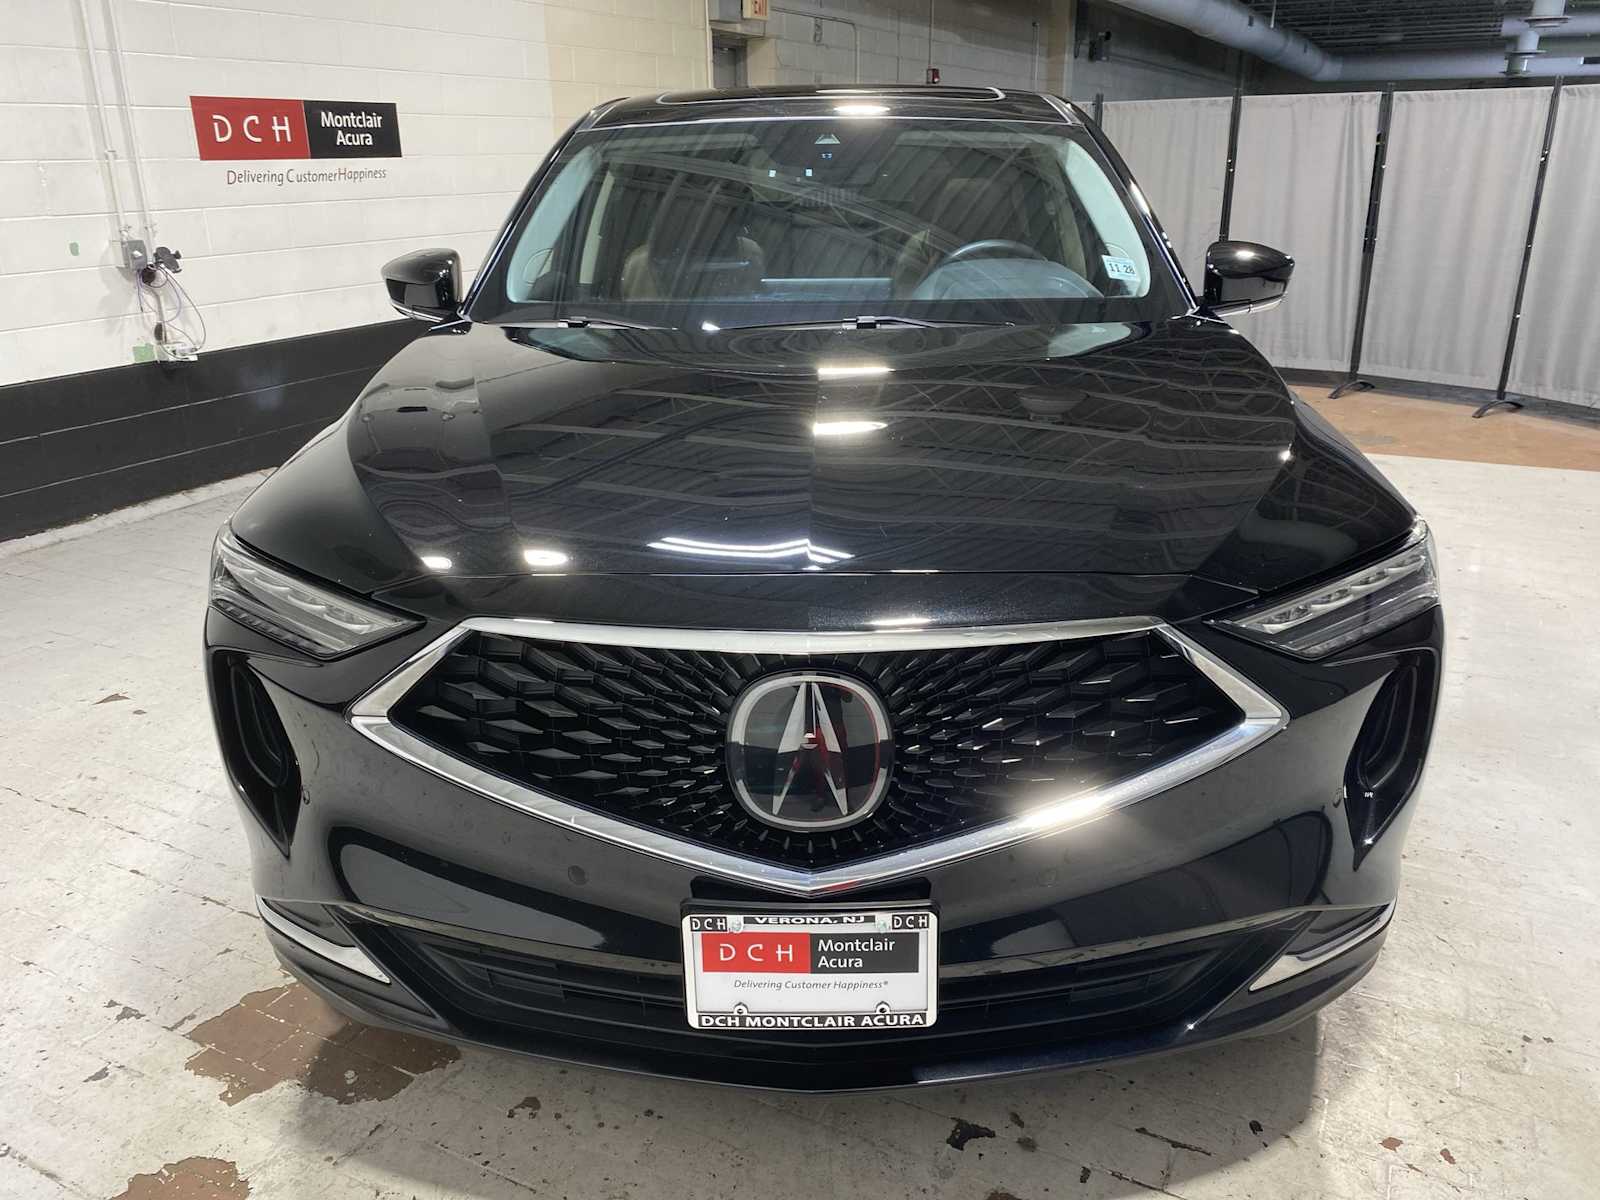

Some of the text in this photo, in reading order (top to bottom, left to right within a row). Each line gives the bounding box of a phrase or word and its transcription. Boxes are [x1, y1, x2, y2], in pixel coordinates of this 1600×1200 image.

[320, 111, 383, 129] Montclair
[336, 130, 374, 146] Acura
[227, 168, 284, 187] Delivering
[692, 918, 727, 931] DCH
[842, 916, 865, 924] NJ
[893, 915, 928, 929] DCH
[818, 938, 896, 952] Montclair
[817, 955, 863, 968] Acura
[734, 979, 782, 991] Delivering
[784, 980, 834, 989] Customer
[701, 1014, 924, 1028] DCH MONTCLAIR ACURA
